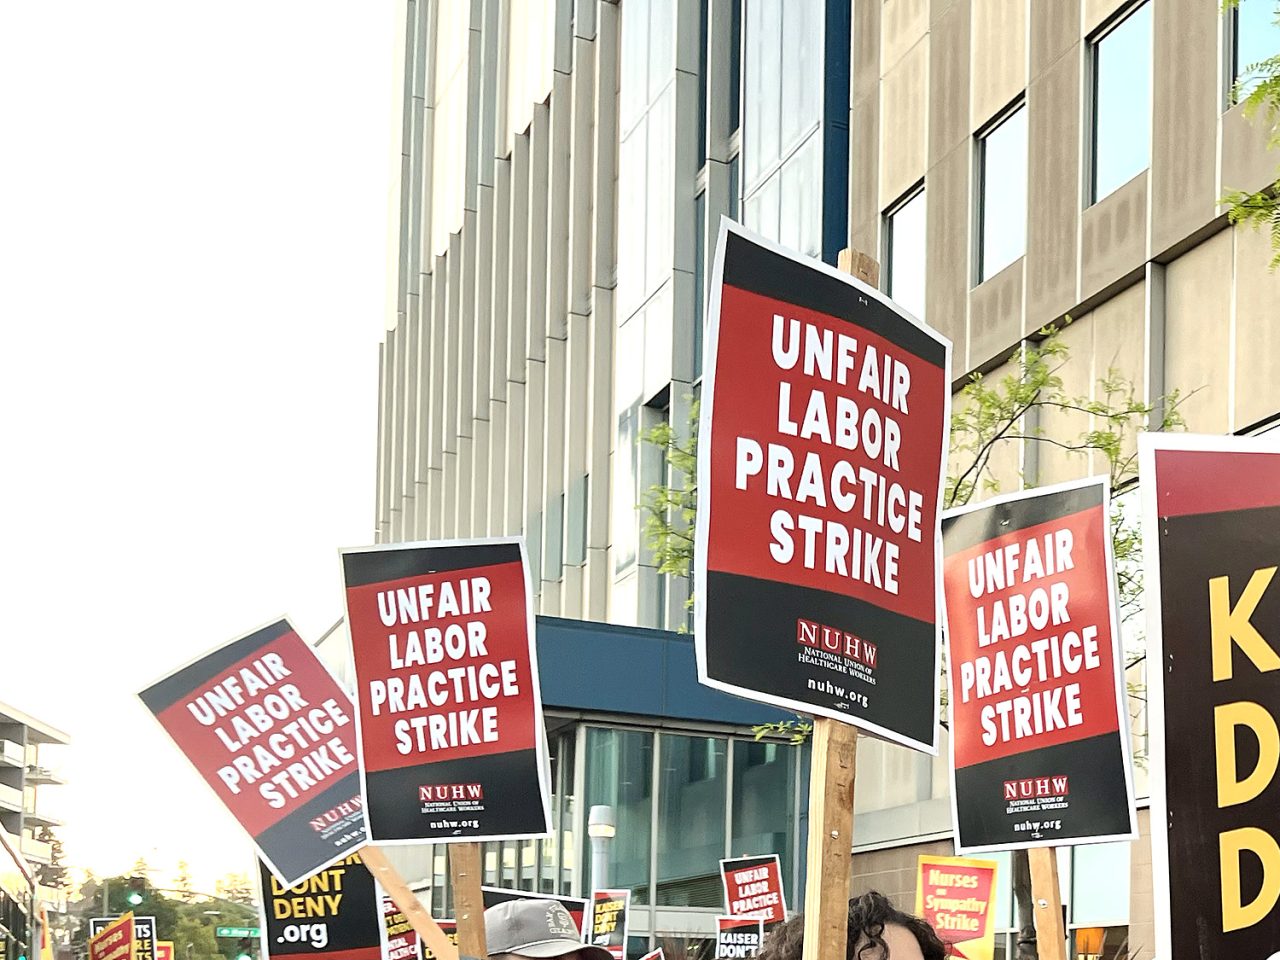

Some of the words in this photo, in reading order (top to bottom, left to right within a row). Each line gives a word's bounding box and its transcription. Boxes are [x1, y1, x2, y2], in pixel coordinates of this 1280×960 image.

[771, 313, 912, 415] UNFAIR
[777, 382, 902, 473] LABOR
[735, 436, 924, 544] PRACTICE
[768, 509, 901, 596] STRIKE
[967, 527, 1076, 598] UNFAIR
[377, 577, 492, 627] UNFAIR
[976, 581, 1071, 648] LABOR
[388, 621, 488, 670] LABOR
[799, 621, 877, 665] NUHW
[804, 646, 843, 664] NATIONAL
[844, 657, 864, 672] UNION
[798, 653, 848, 674] HEALTHCARE
[849, 667, 876, 685] WORKERS
[959, 625, 1100, 703] PRACTICE
[186, 652, 292, 726] UNFAIR
[370, 660, 519, 716] PRACTICE
[807, 678, 869, 708] nuhw.org
[214, 683, 309, 753] LABOR
[394, 707, 499, 755] STRIKE
[980, 681, 1084, 748] STRIKE
[217, 698, 351, 795] PRACTICE
[258, 737, 355, 809] STRIKE
[420, 784, 482, 800] NUHW
[1004, 776, 1068, 798] NUHW
[309, 795, 362, 832] NUHW
[430, 820, 480, 828] nuhw.org
[1014, 820, 1062, 831] nuhw.org
[734, 866, 769, 885] UNFAIR
[738, 880, 769, 898] LABOR
[929, 869, 978, 888] Nurses
[273, 894, 343, 920] DENY
[732, 892, 779, 913] PRACTICE
[926, 895, 987, 915] Sympathy
[936, 912, 979, 931] Strike
[277, 923, 329, 948] .org
[720, 933, 758, 945] KAISER
